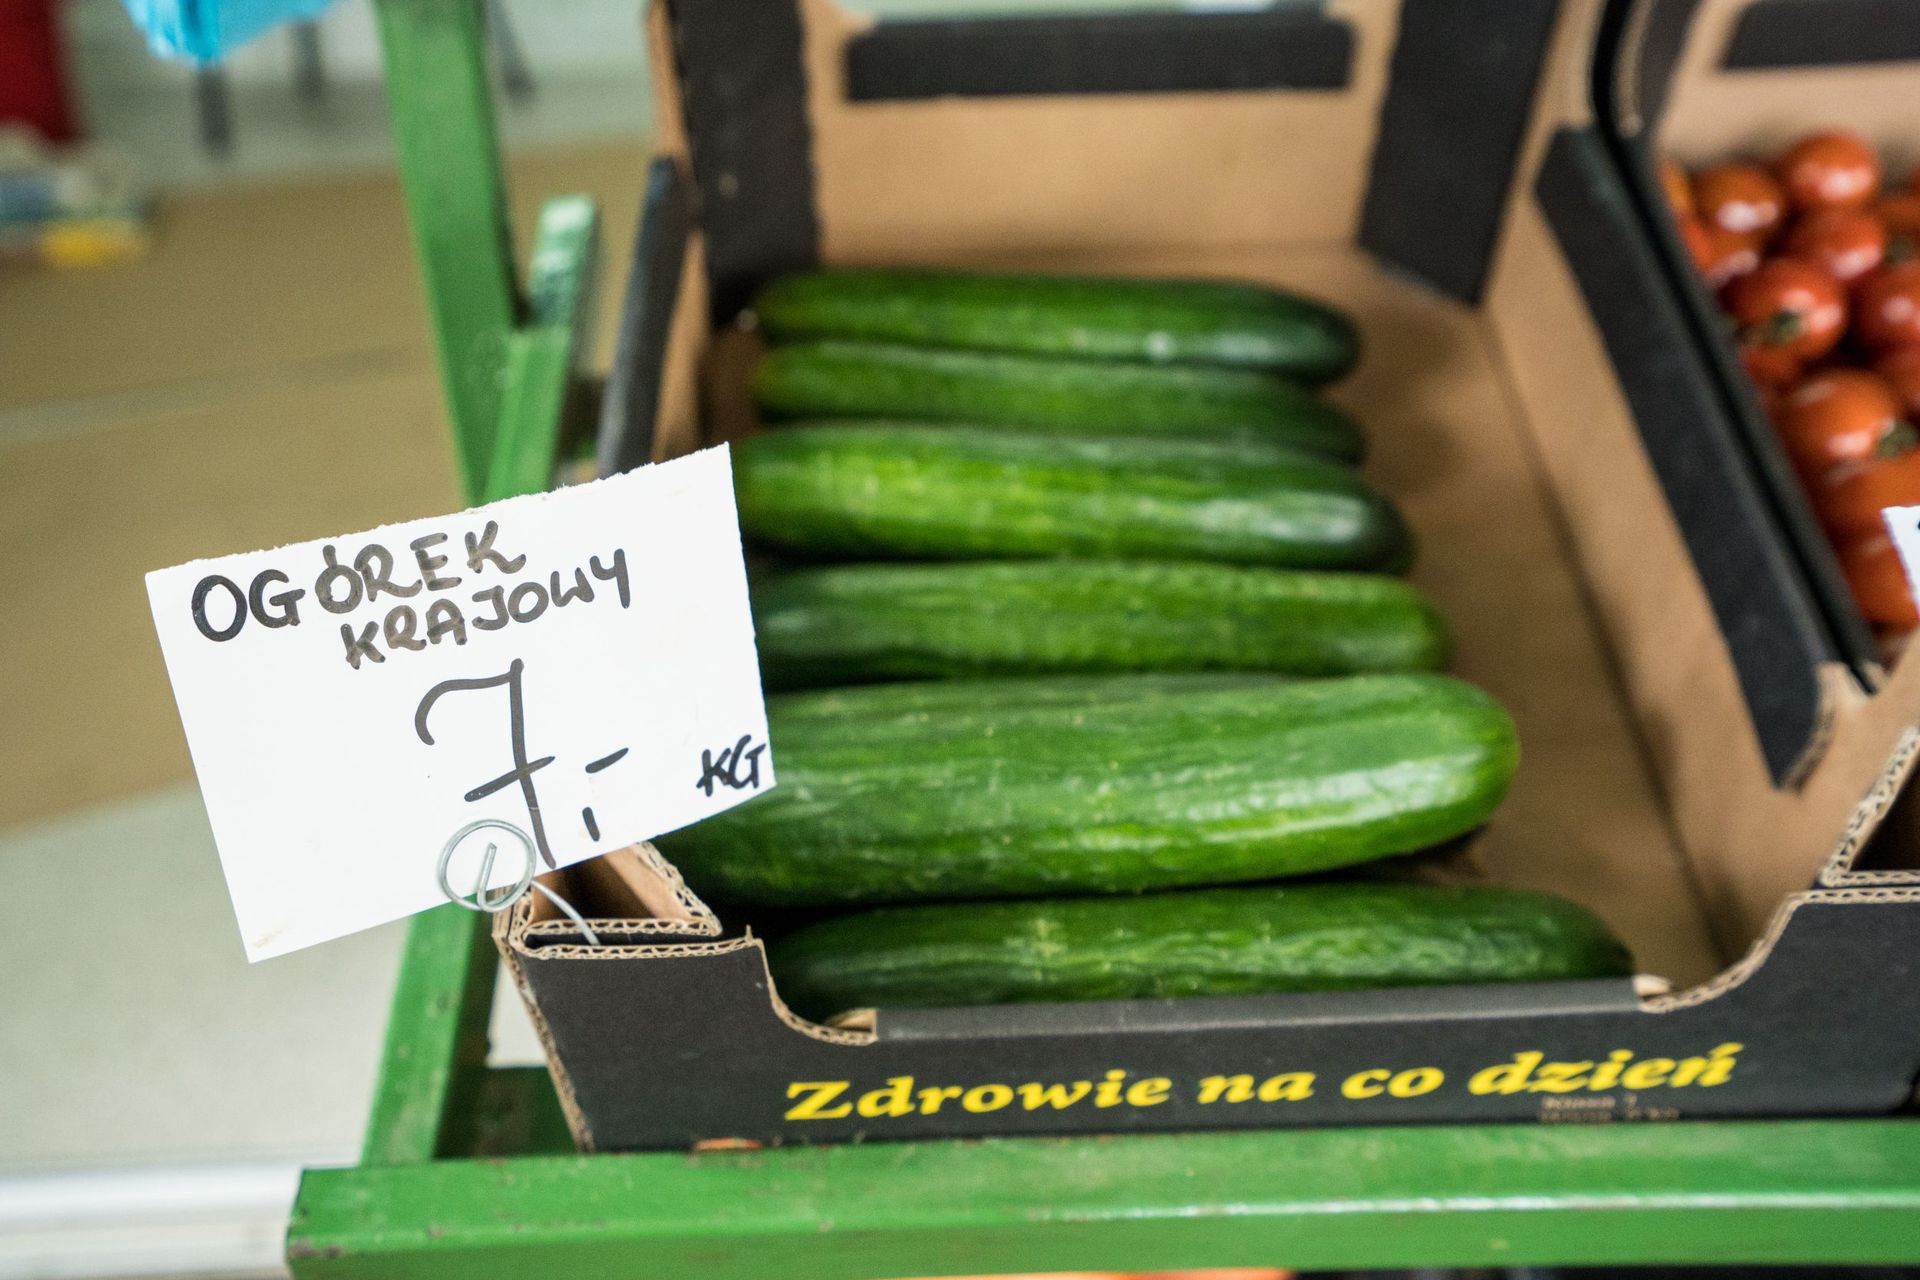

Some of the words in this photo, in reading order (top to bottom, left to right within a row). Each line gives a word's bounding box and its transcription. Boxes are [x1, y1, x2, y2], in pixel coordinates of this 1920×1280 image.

[192, 521, 526, 642] OGÓREK
[341, 549, 631, 669] KRAJOWY
[697, 735, 767, 797] KG
[784, 1069, 1173, 1121] Zdrowie
[1198, 1072, 1315, 1104] na
[1341, 1067, 1445, 1099] co
[1468, 1042, 1744, 1095] dzień
